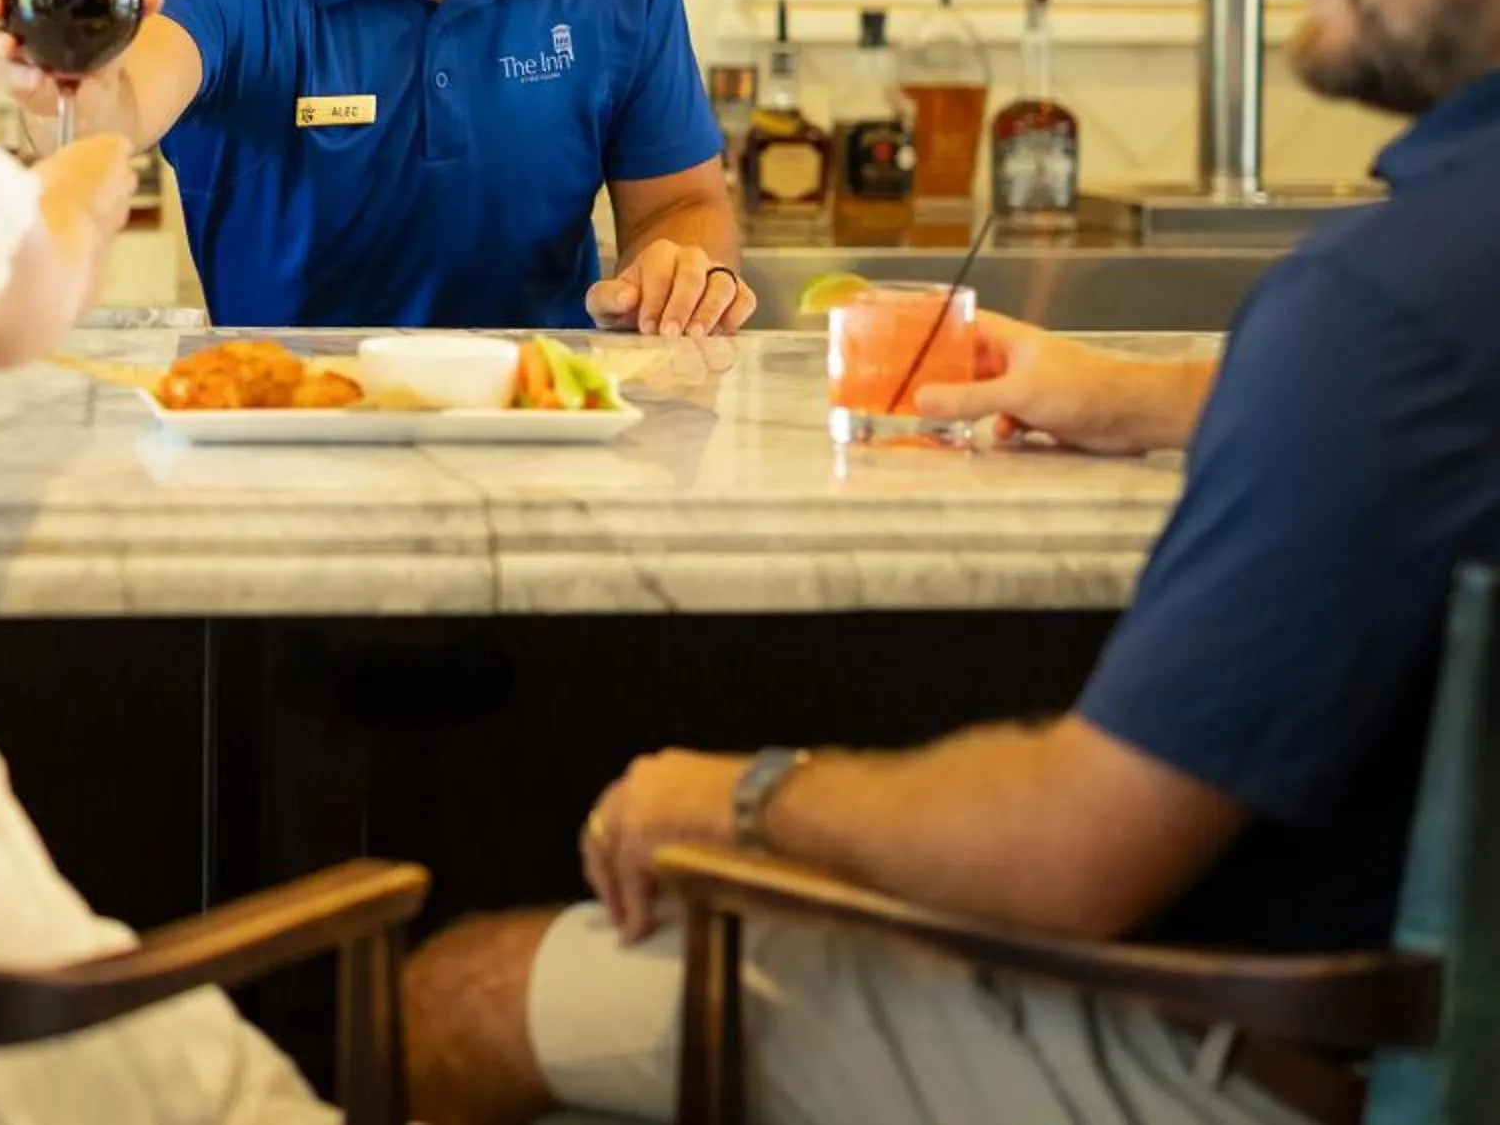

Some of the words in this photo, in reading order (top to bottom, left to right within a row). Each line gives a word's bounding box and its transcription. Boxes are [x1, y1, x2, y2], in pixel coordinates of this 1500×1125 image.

[499, 56, 537, 78] The
[540, 51, 571, 72] Inn
[331, 106, 359, 118] ALEC
